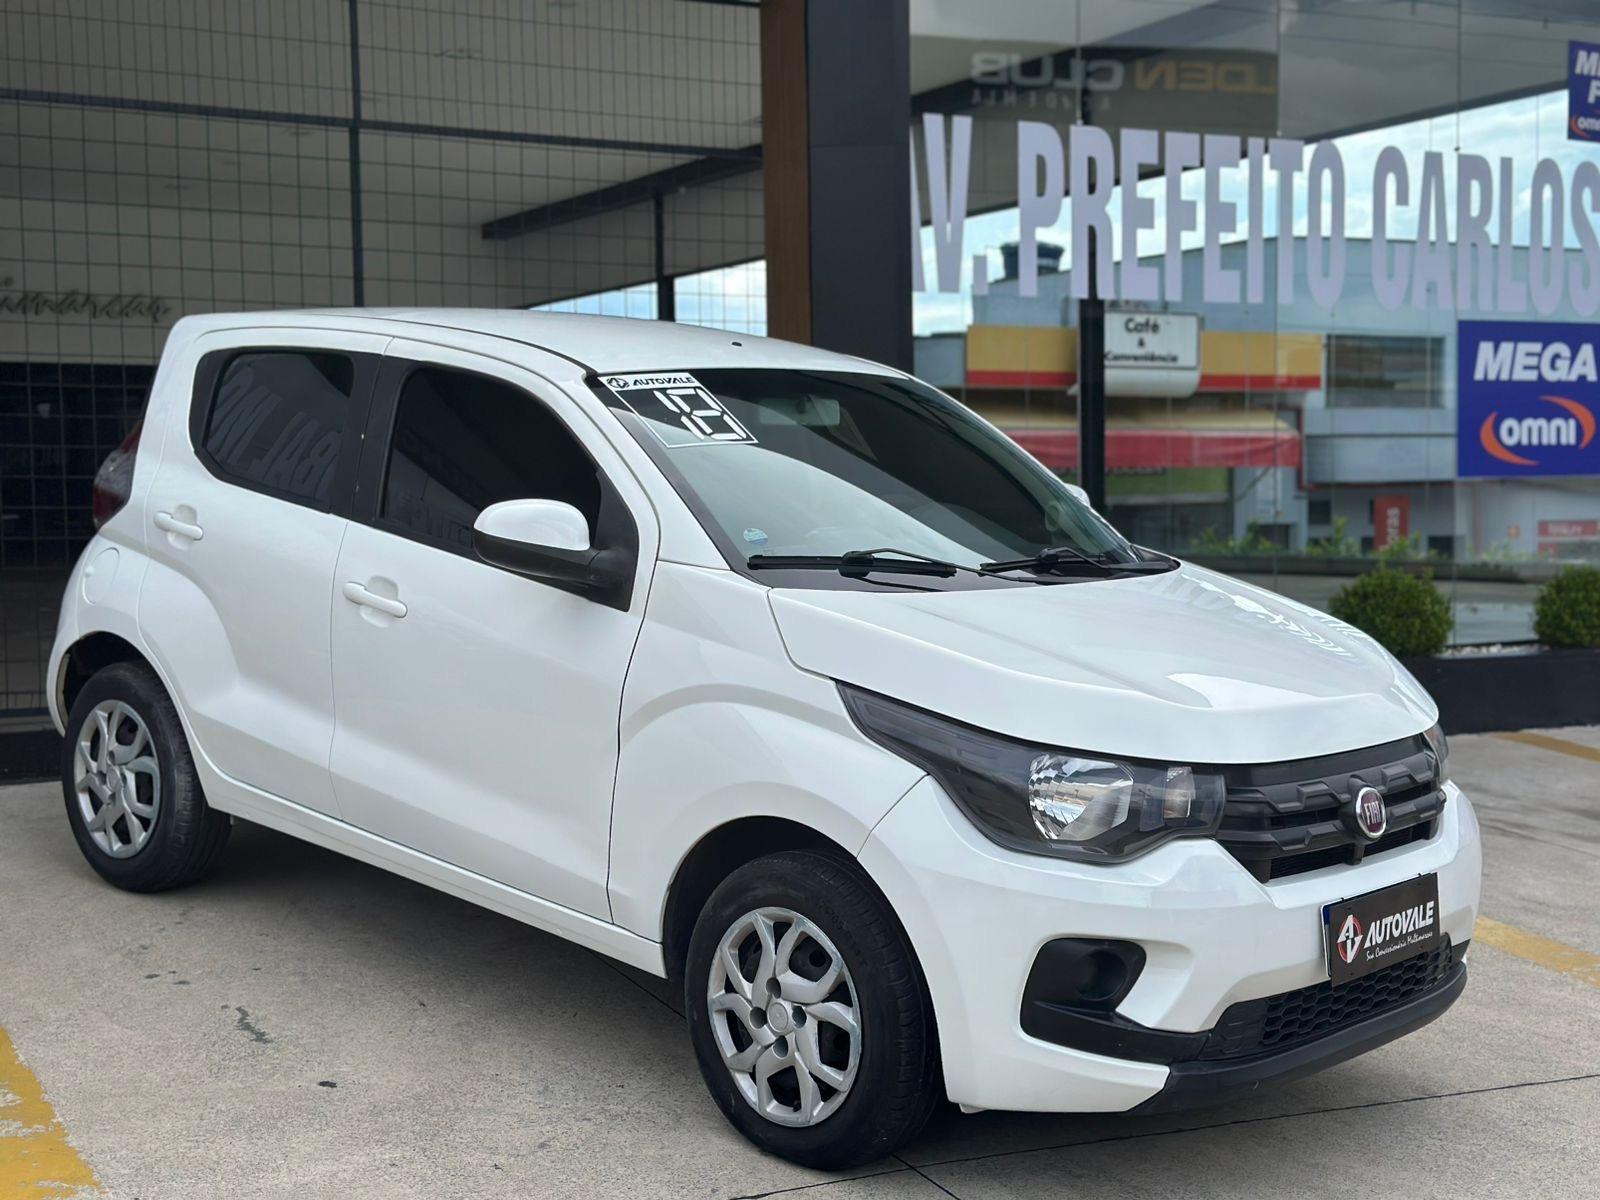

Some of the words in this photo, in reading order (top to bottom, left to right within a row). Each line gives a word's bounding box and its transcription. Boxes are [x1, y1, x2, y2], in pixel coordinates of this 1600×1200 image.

[1017, 120, 1345, 312] PREFEITO
[1371, 145, 1600, 317] CARLOS
[1124, 316, 1159, 333] Café
[1473, 341, 1598, 382] MEGA
[633, 376, 695, 386] AUTOVALE
[653, 388, 747, 440] 18
[1499, 417, 1577, 446] omni
[1364, 800, 1381, 825] FIAT
[1364, 901, 1434, 949] AUTOVALE
